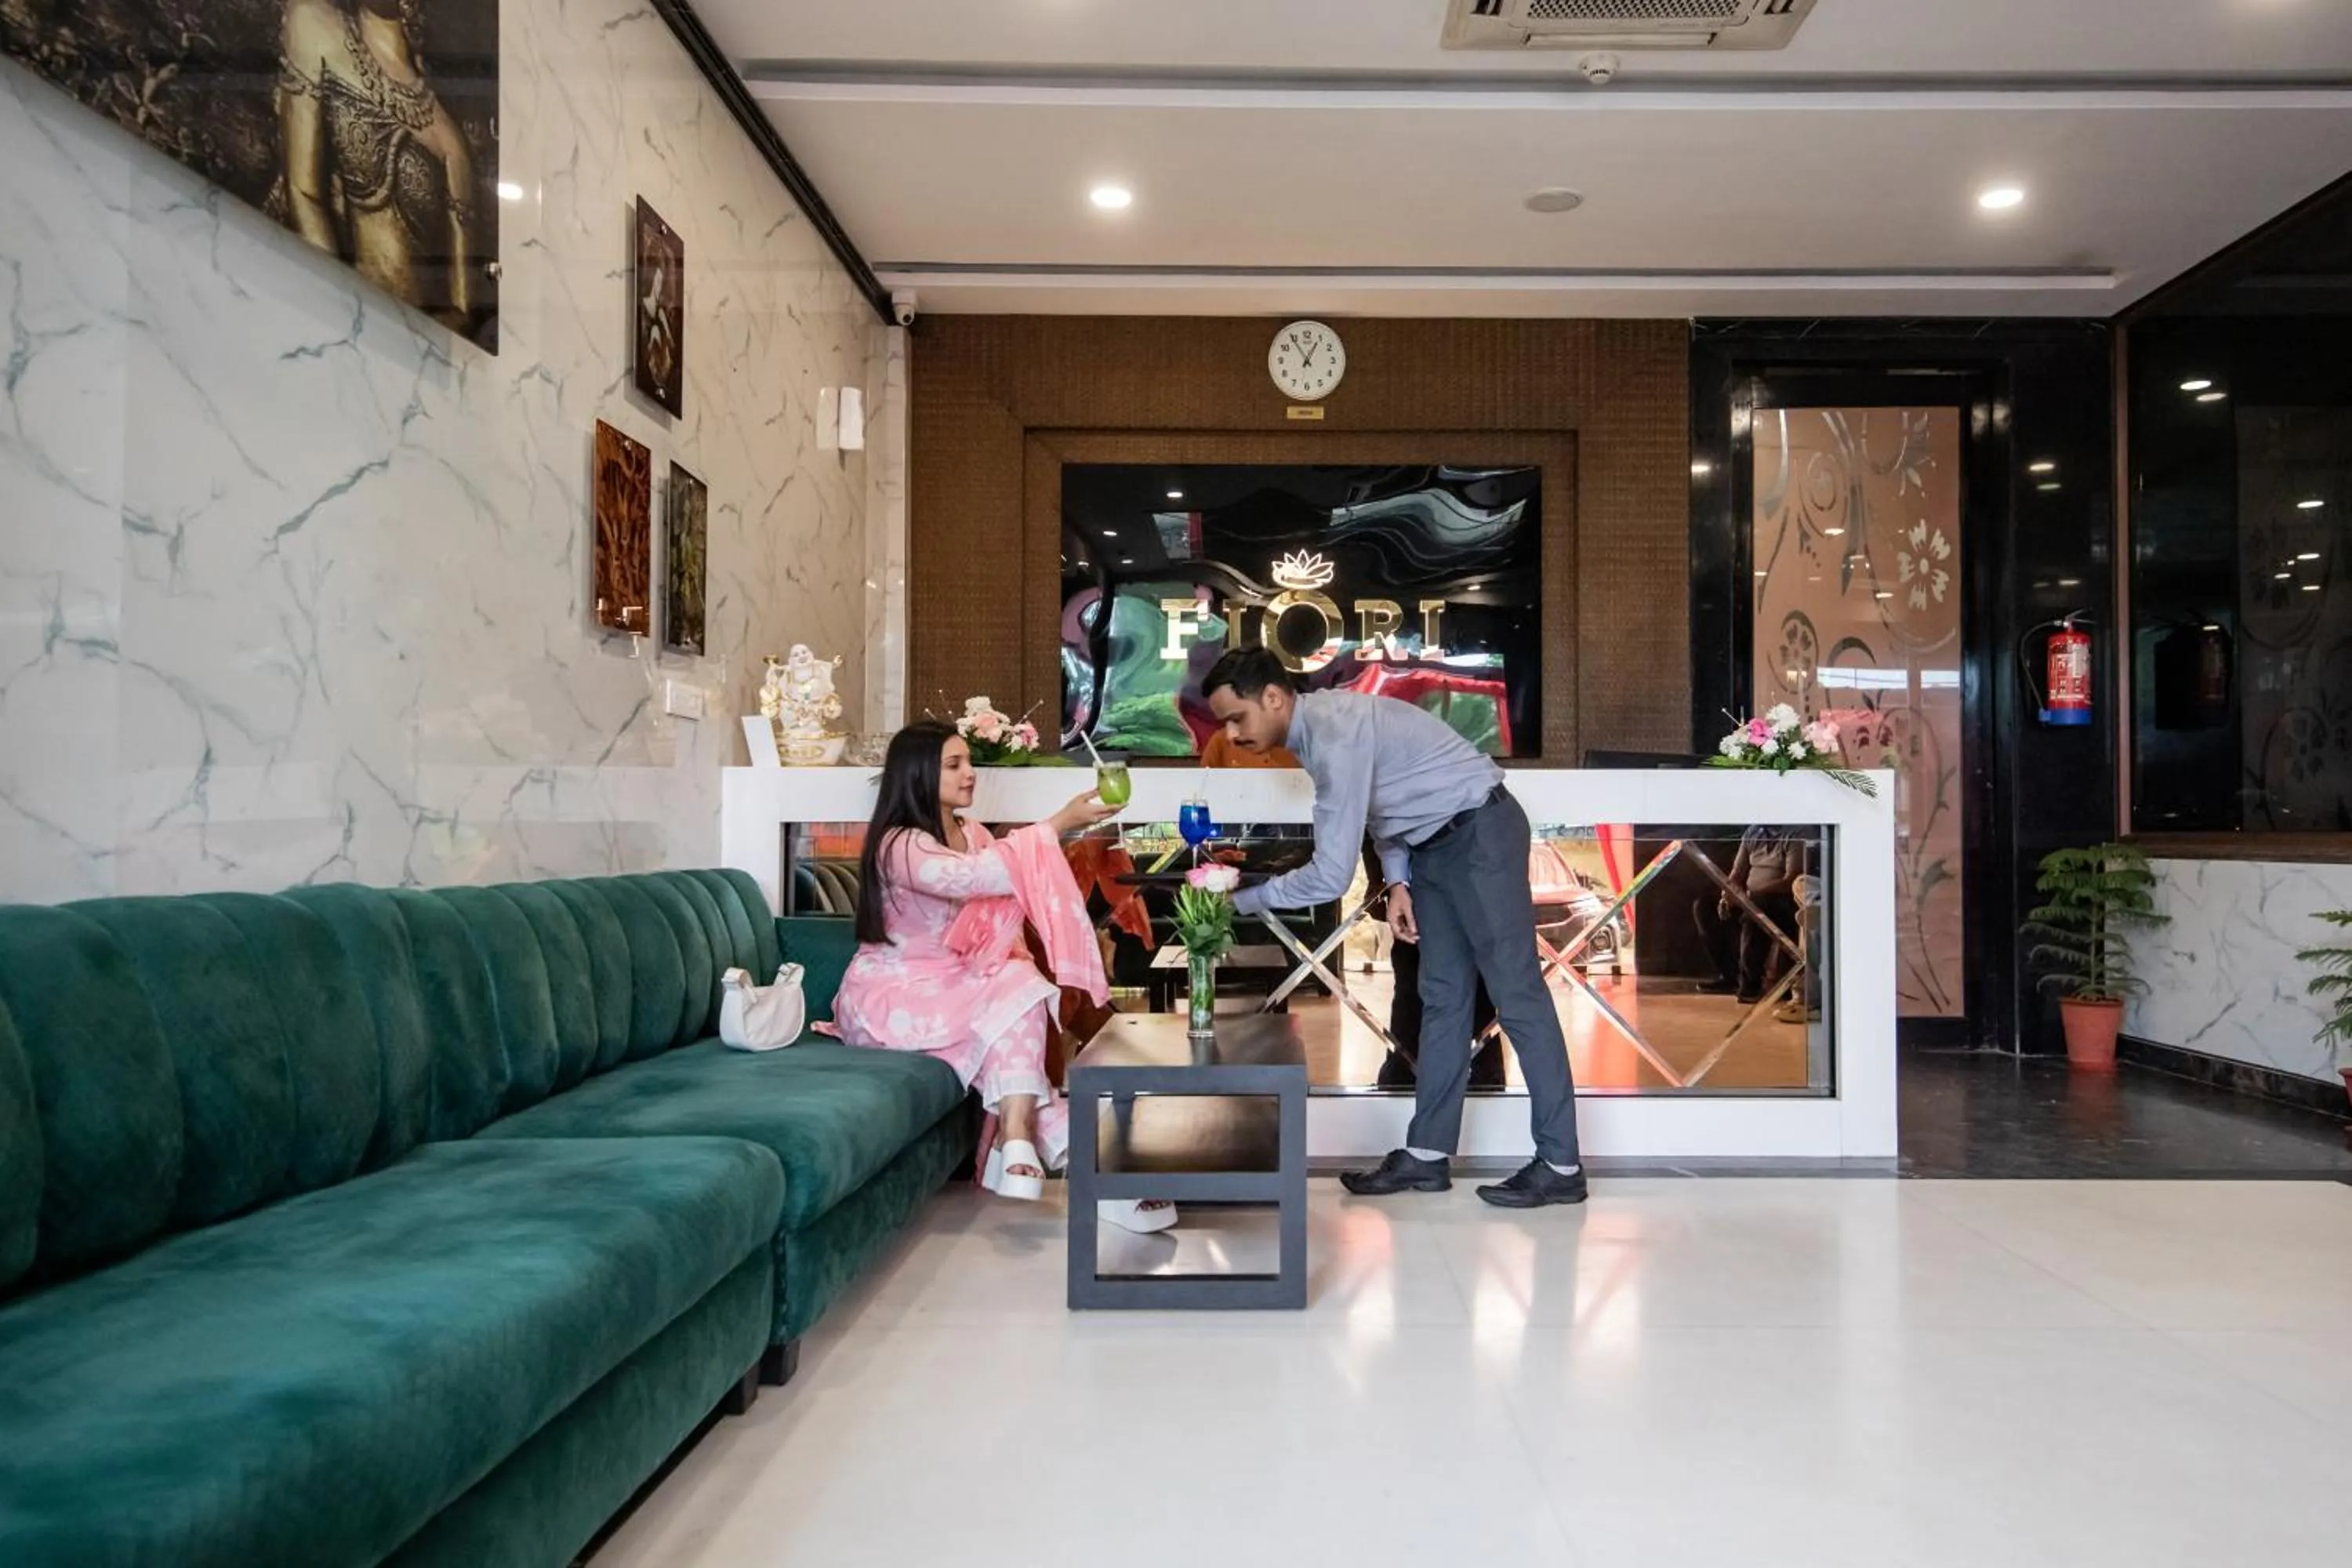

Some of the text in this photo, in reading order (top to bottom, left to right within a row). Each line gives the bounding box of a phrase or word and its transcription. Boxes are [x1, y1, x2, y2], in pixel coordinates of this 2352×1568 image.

[1302, 330, 1312, 339] 12
[1327, 343, 1332, 352] 2
[1160, 589, 1446, 673] FIORI
